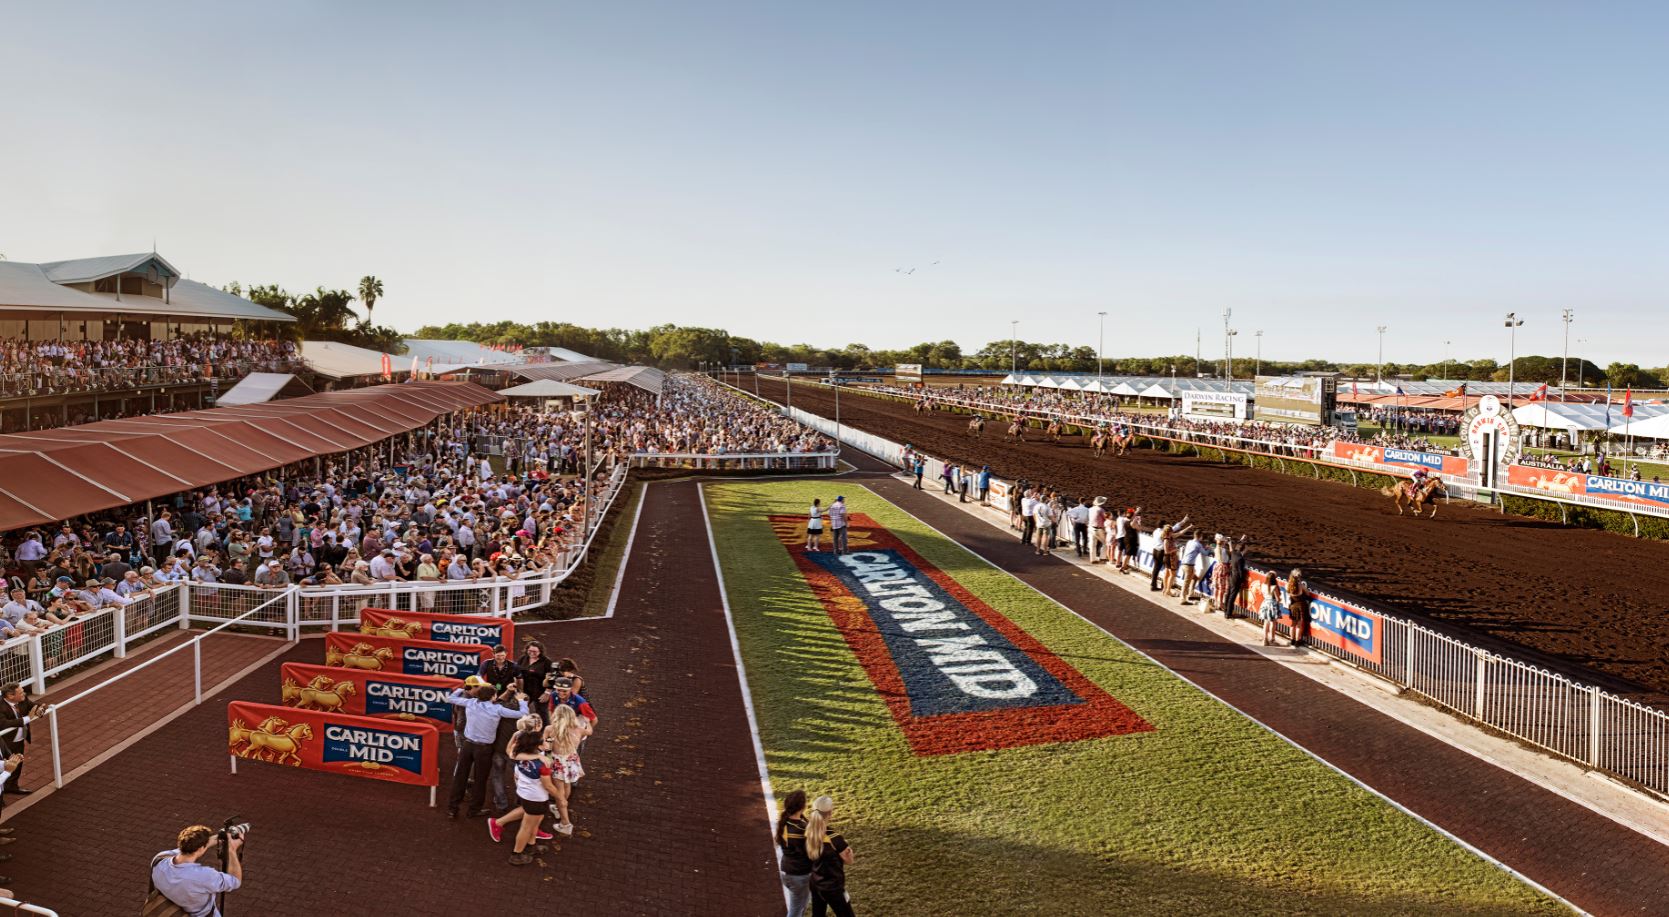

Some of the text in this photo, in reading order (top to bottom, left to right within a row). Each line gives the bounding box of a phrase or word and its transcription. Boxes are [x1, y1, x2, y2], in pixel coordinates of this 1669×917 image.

[1184, 391, 1244, 403] DARWIN RACING
[1460, 416, 1472, 458] WELCOME
[1468, 407, 1478, 418] TO
[1471, 417, 1507, 436] DARWIN CUP
[1384, 449, 1442, 465] CARLTON MID
[1520, 460, 1565, 471] AUSTRALIA
[1587, 476, 1646, 495] CARLTON
[432, 623, 500, 637] CARLTON
[838, 551, 1038, 700] CARLTON MID
[1335, 610, 1371, 640] MID
[449, 636, 482, 645] MID
[404, 649, 479, 666] CARLTON
[423, 662, 459, 675] MID
[367, 683, 451, 704] CARLTON
[388, 699, 428, 714] MID
[326, 726, 421, 751] CARLTON
[349, 744, 394, 763] MID
